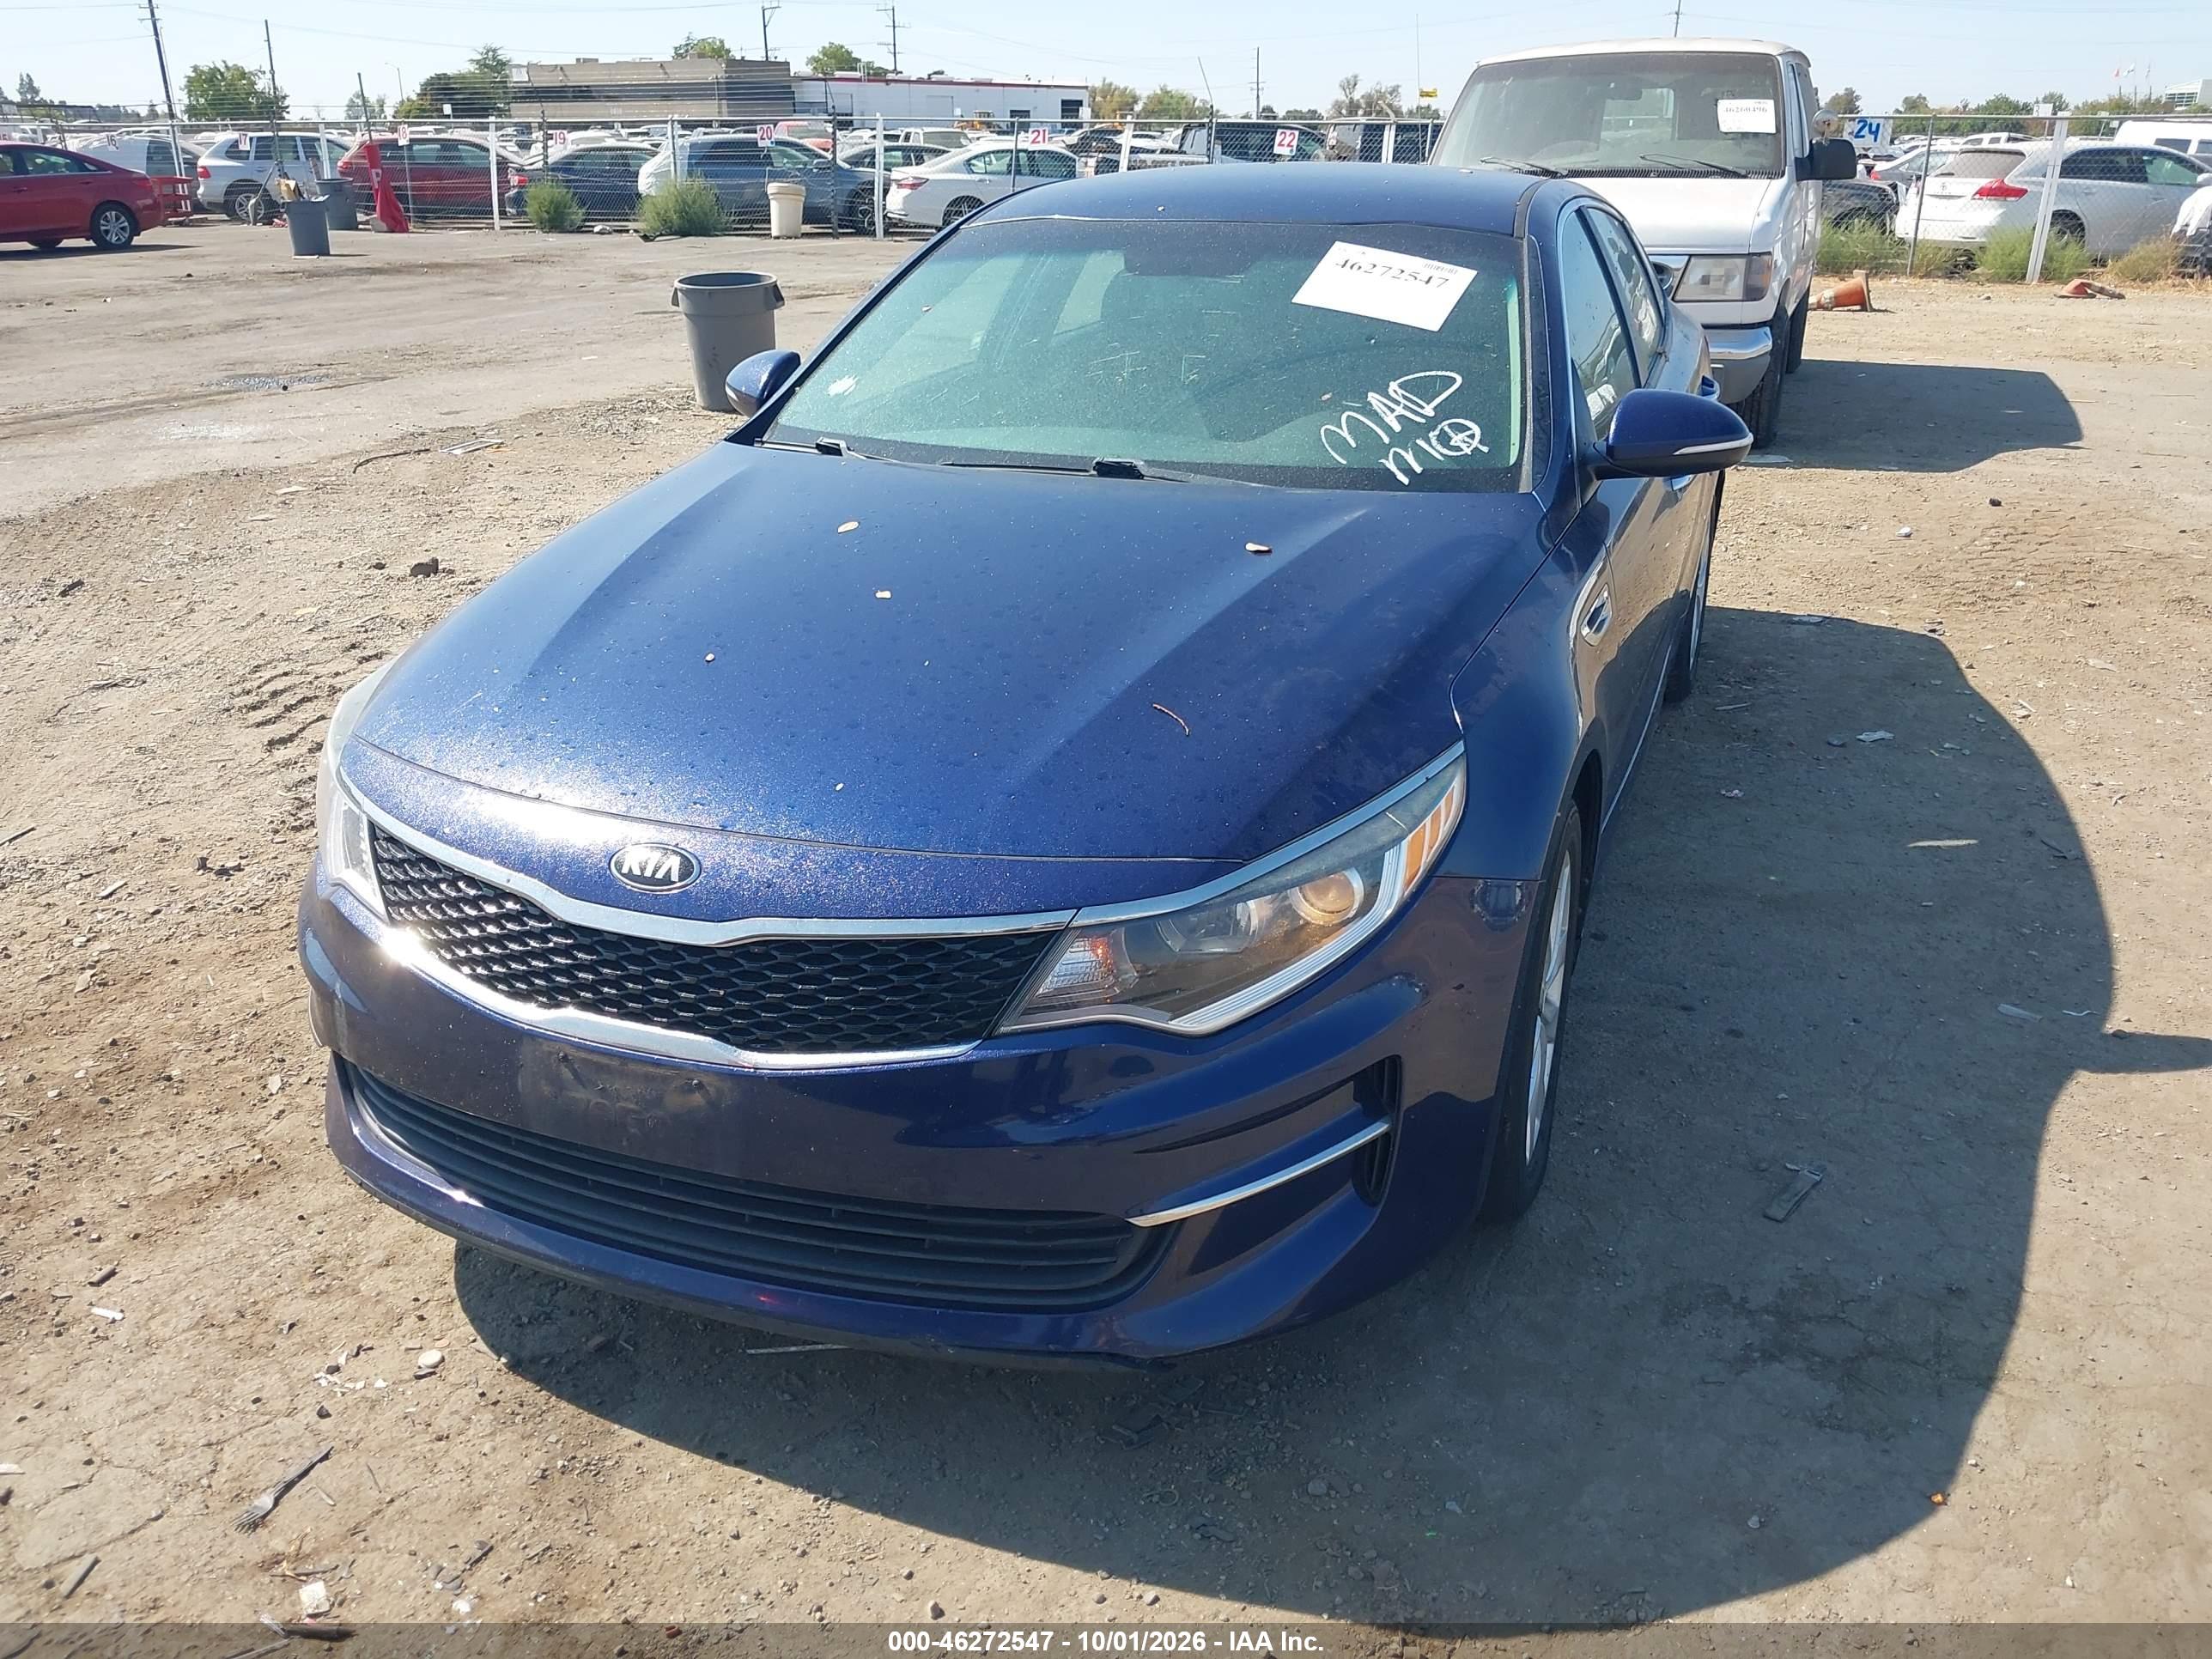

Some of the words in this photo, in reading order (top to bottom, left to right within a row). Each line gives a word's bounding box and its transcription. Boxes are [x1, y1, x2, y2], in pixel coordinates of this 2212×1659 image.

[239, 132, 248, 145] 17
[398, 126, 408, 140] 18
[555, 131, 566, 145] 19
[759, 125, 773, 141] 20
[1030, 129, 1047, 144] 21
[1854, 118, 1881, 143] 24
[1277, 131, 1296, 148] 22
[1335, 258, 1449, 289] 46272547
[621, 848, 681, 882] KIA
